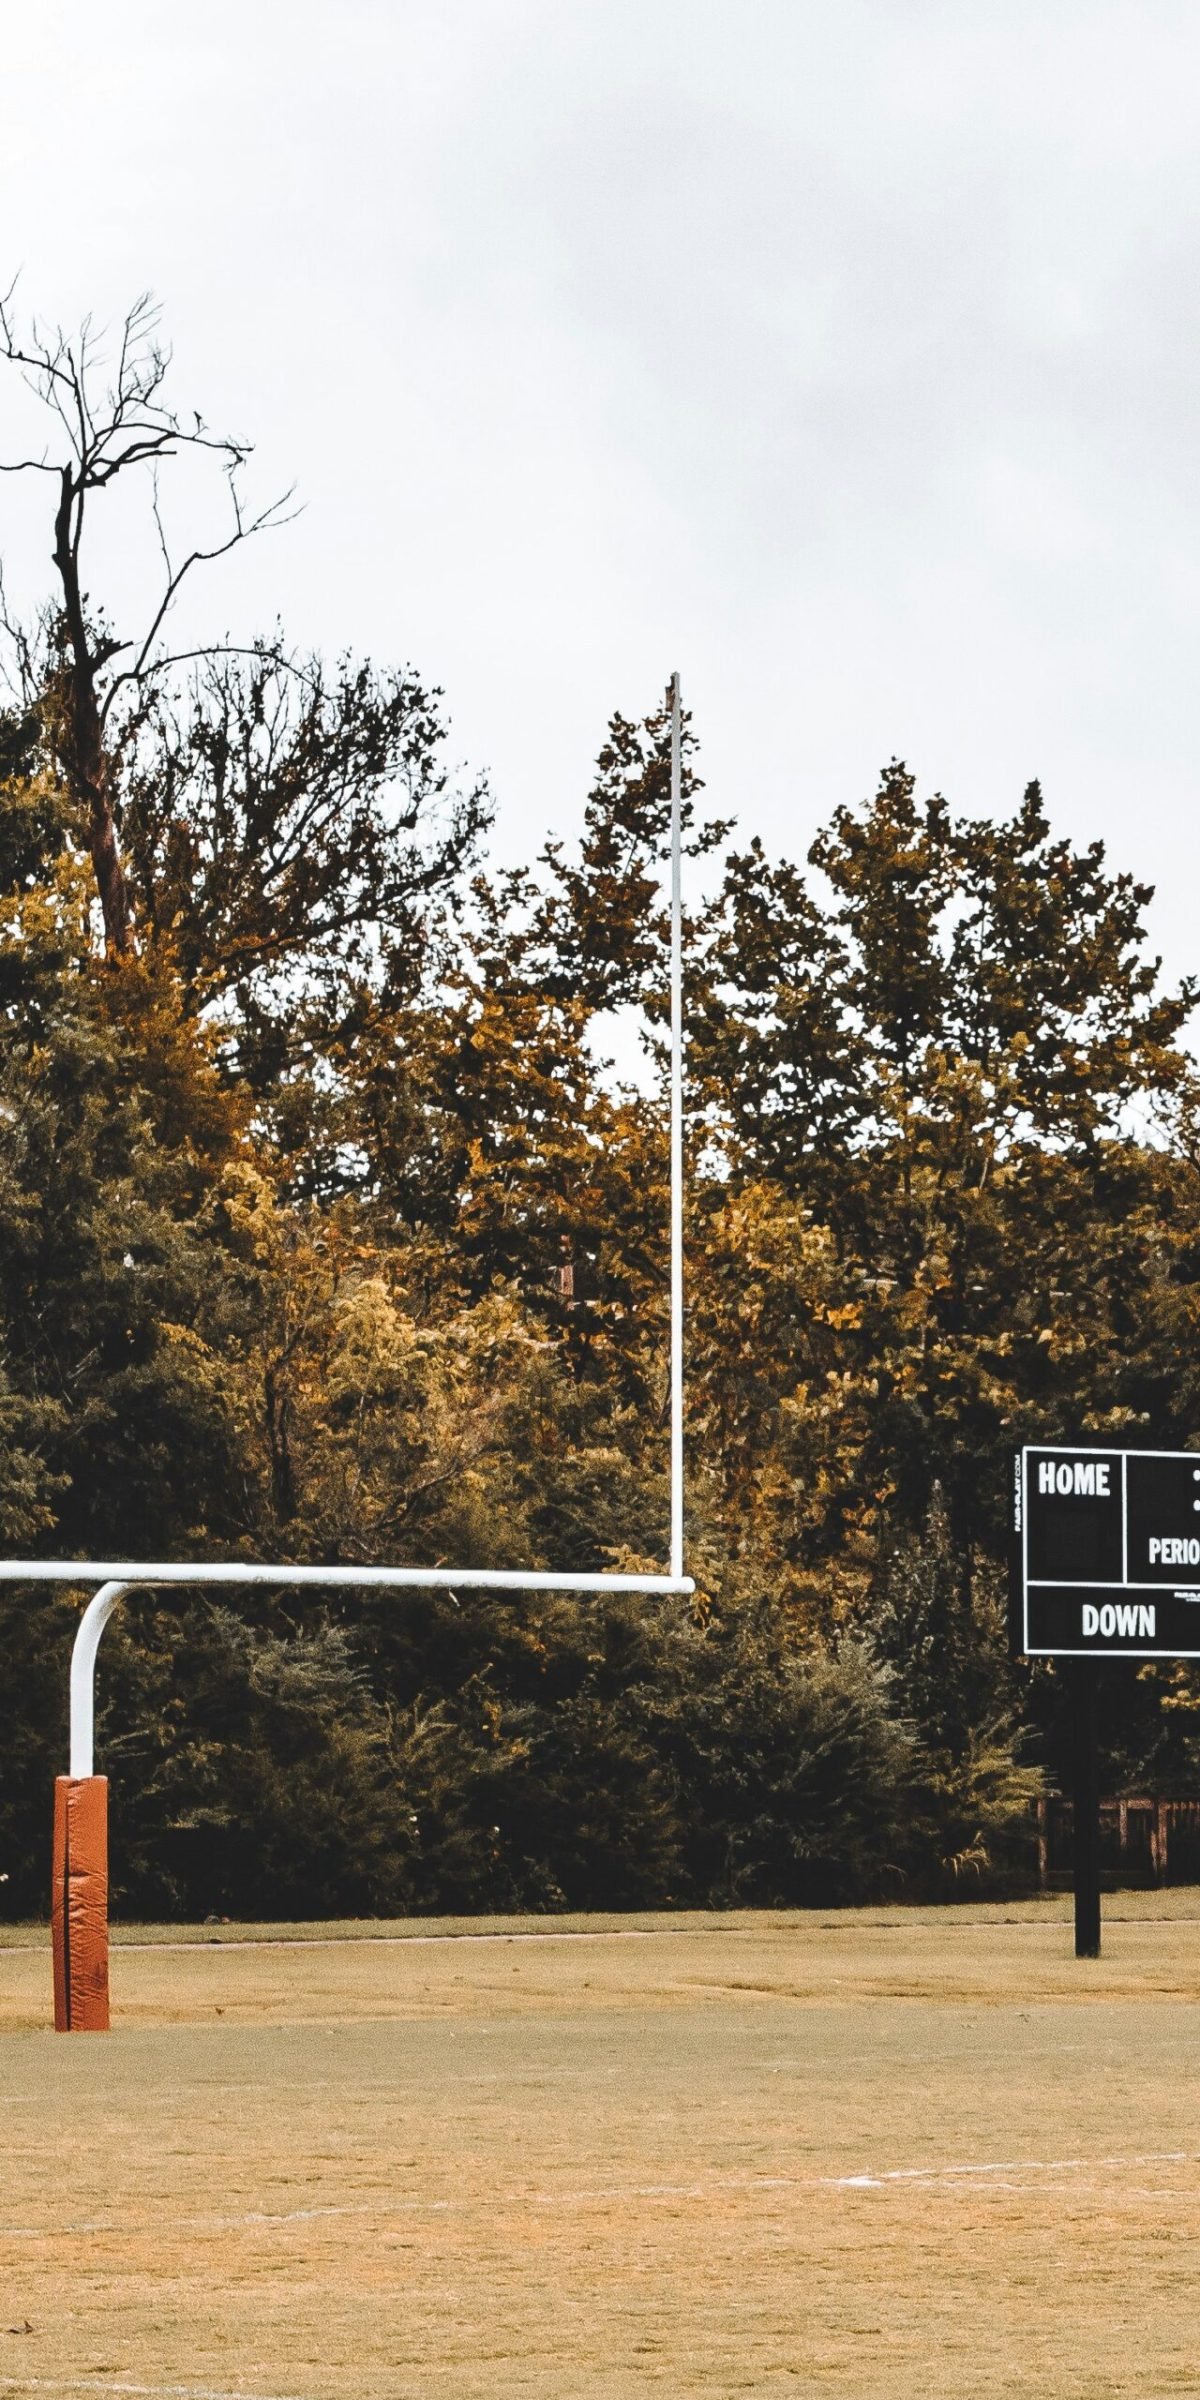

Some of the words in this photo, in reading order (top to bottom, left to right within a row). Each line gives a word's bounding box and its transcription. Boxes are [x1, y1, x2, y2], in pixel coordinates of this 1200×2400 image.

[1038, 1461, 1111, 1497] HOME
[1149, 1537, 1200, 1565] PERIO
[1082, 1603, 1156, 1637] DOWN
